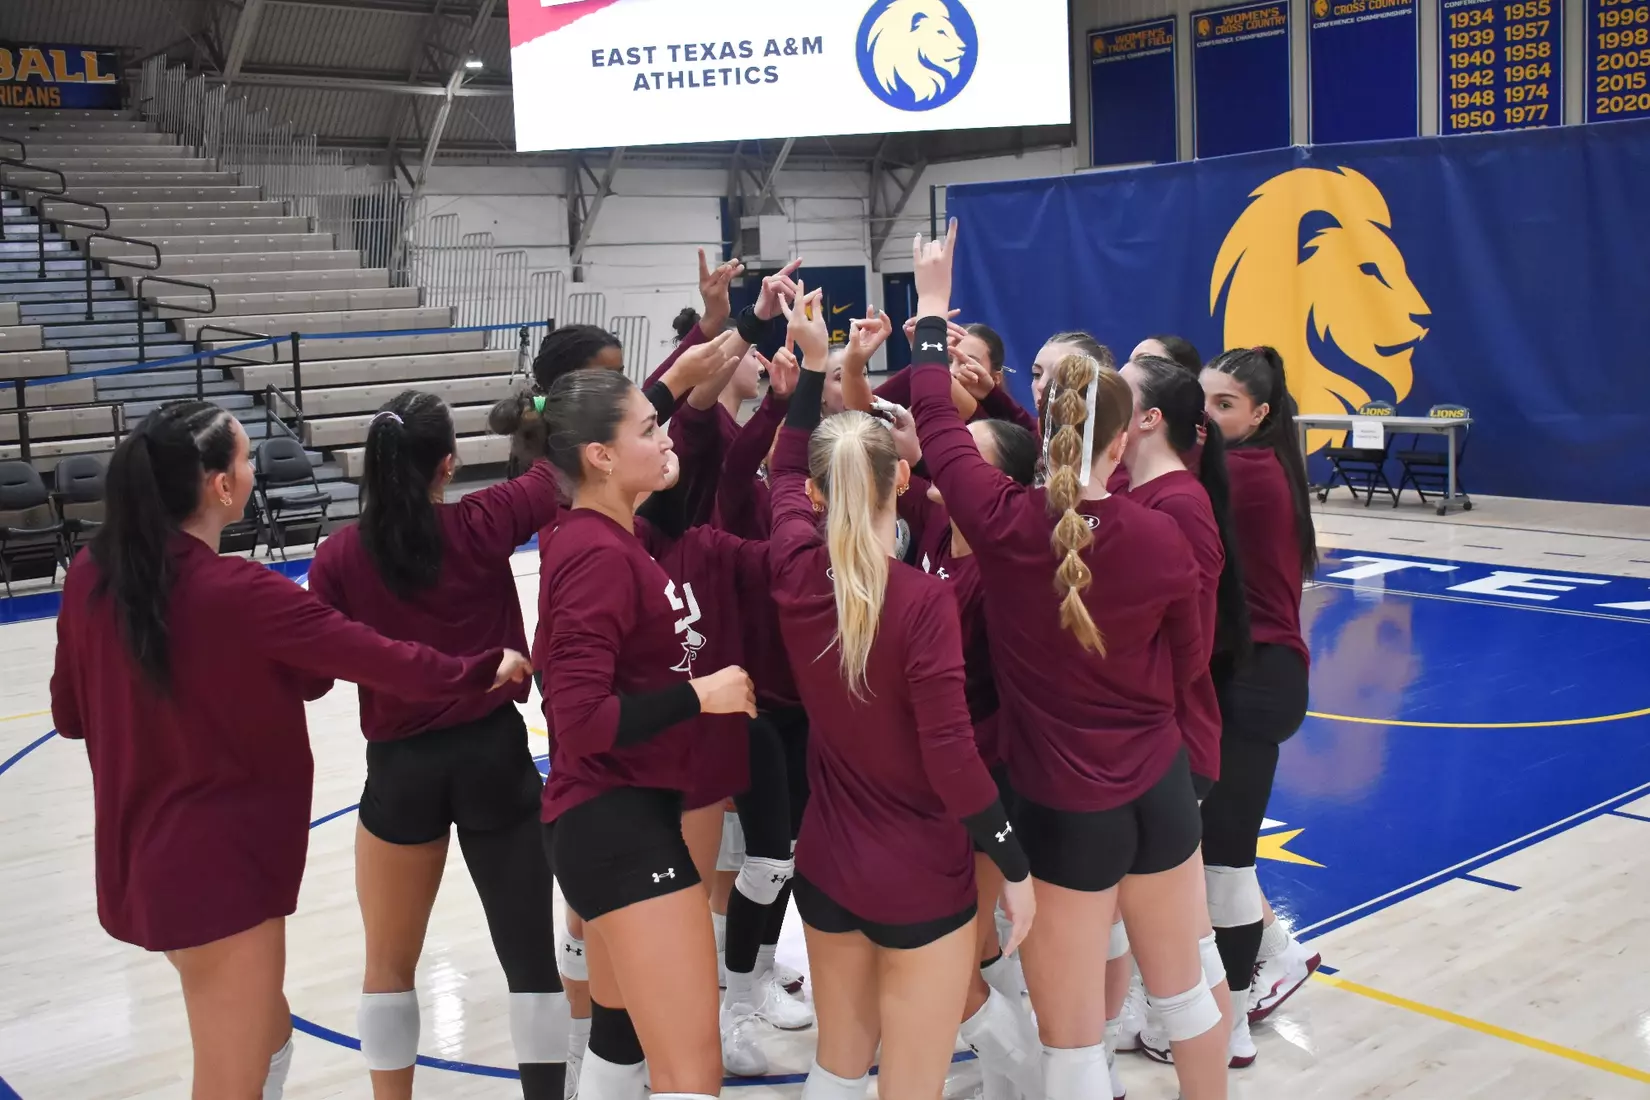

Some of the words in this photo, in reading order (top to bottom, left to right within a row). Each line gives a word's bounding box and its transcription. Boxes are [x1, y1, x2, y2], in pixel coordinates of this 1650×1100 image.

[1333, 4, 1365, 15] CROSS
[1443, 0, 1491, 8] CONFEREN
[1504, 0, 1551, 21] 1955
[1215, 21, 1243, 35] CROSS
[1246, 15, 1286, 30] COUNTRY
[1222, 7, 1279, 25] WOMEN'S
[1312, 17, 1355, 29] CONFERENCE
[1356, 8, 1412, 22] CHAMPIONSHIPS
[1449, 8, 1494, 28] 1934
[1597, 6, 1649, 28] 1996
[1449, 28, 1495, 48] 1939
[1504, 20, 1550, 41] 1957
[1597, 28, 1649, 49] 1998
[591, 46, 657, 68] EAST
[667, 40, 754, 63] TEXAS
[763, 36, 823, 57] A&M
[1449, 49, 1495, 69] 1940
[1504, 41, 1551, 62] 1958
[1596, 49, 1650, 71] 2005
[633, 65, 779, 91] ATHLETICS
[1450, 69, 1494, 89] 1942
[1504, 62, 1551, 82] 1964
[1596, 72, 1647, 92] 2015
[1450, 90, 1495, 109] 1948
[1504, 83, 1549, 103] 1974
[1504, 104, 1549, 123] 1977
[1596, 93, 1650, 114] 2020
[1450, 110, 1495, 129] 1950
[1360, 407, 1392, 416] LIONS
[1430, 409, 1465, 418] LIONS
